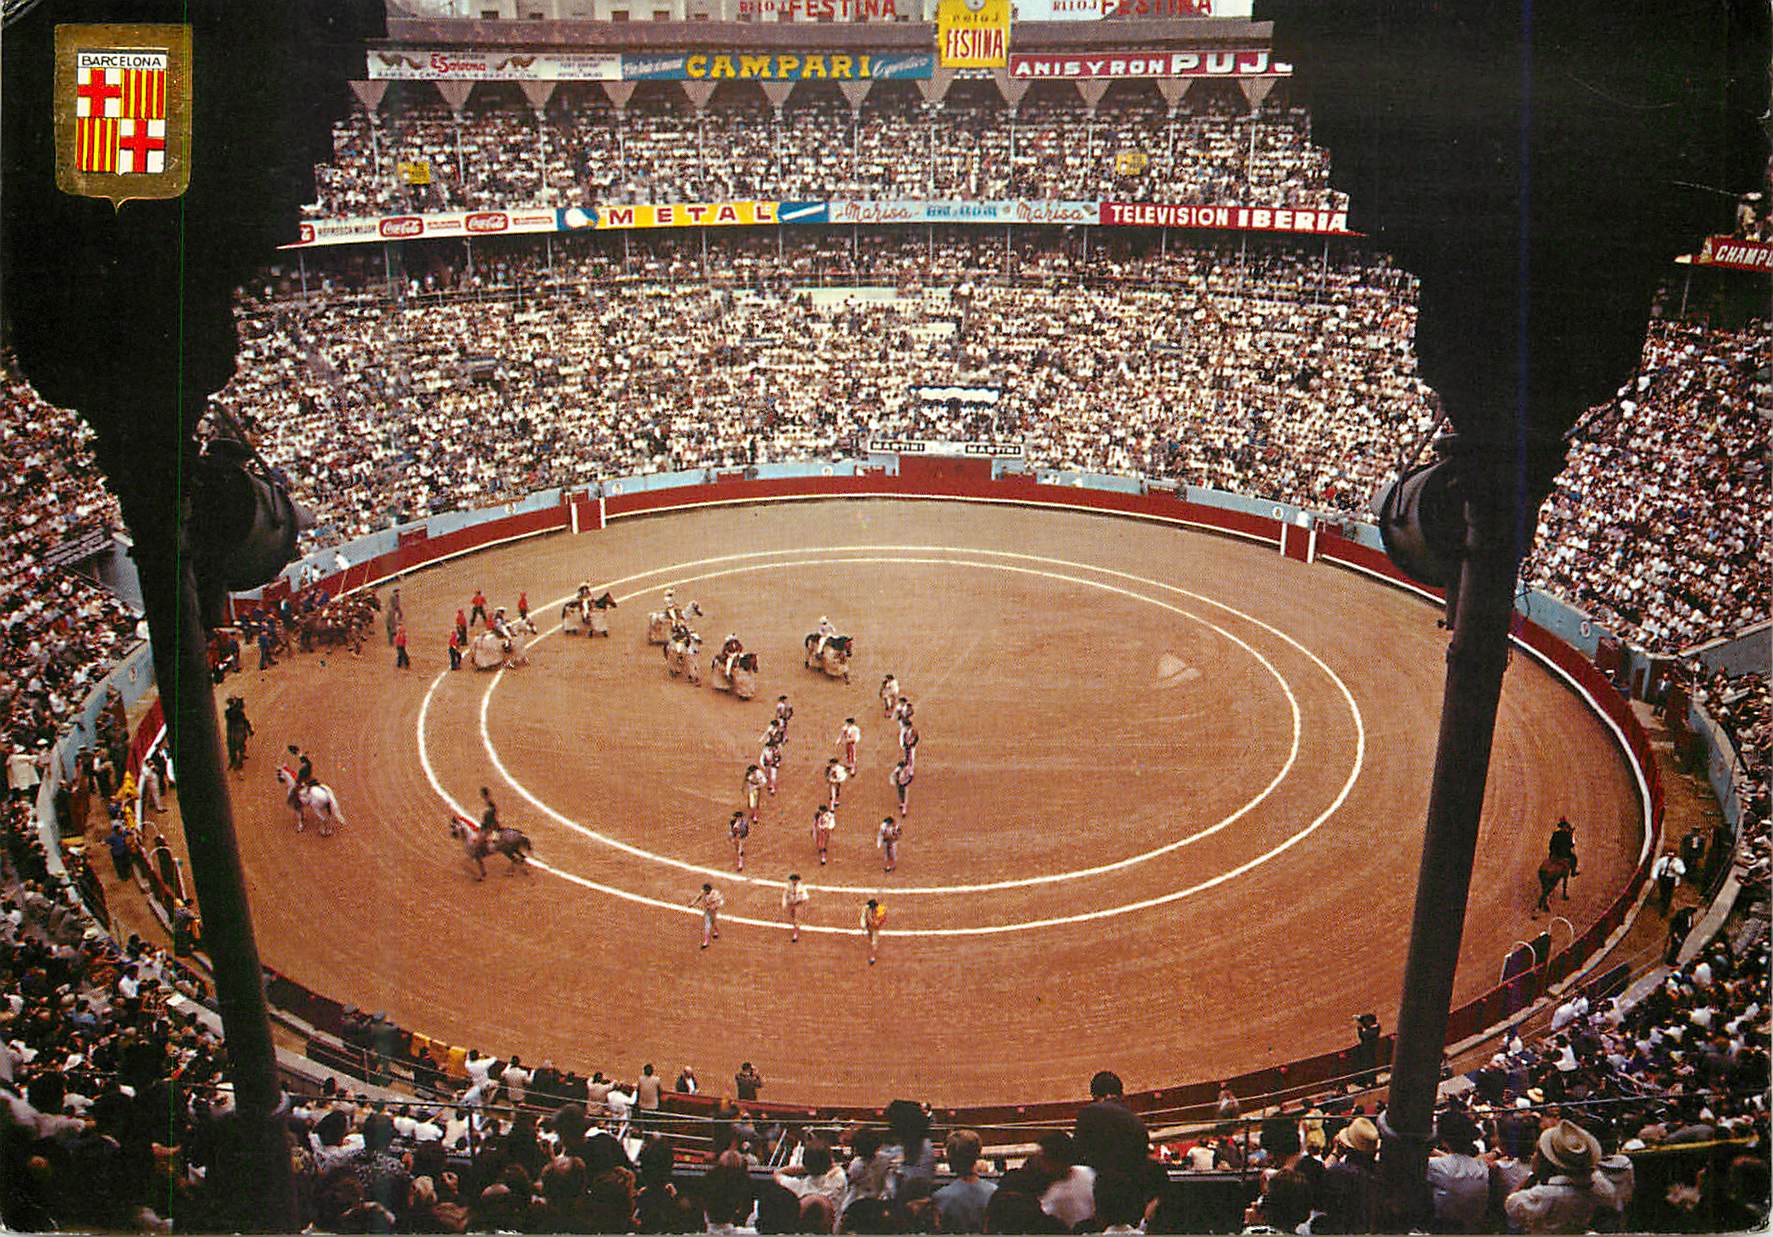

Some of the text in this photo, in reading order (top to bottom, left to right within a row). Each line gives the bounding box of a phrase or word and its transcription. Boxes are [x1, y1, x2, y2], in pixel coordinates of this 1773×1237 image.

[787, 0, 896, 17] FESTINA
[1101, 0, 1213, 15] FESTINA
[946, 29, 1005, 59] FESTINA
[686, 54, 870, 79] CAMPARI
[608, 205, 772, 225] METAL
[1110, 205, 1350, 232] TELEVISION IBERIA
